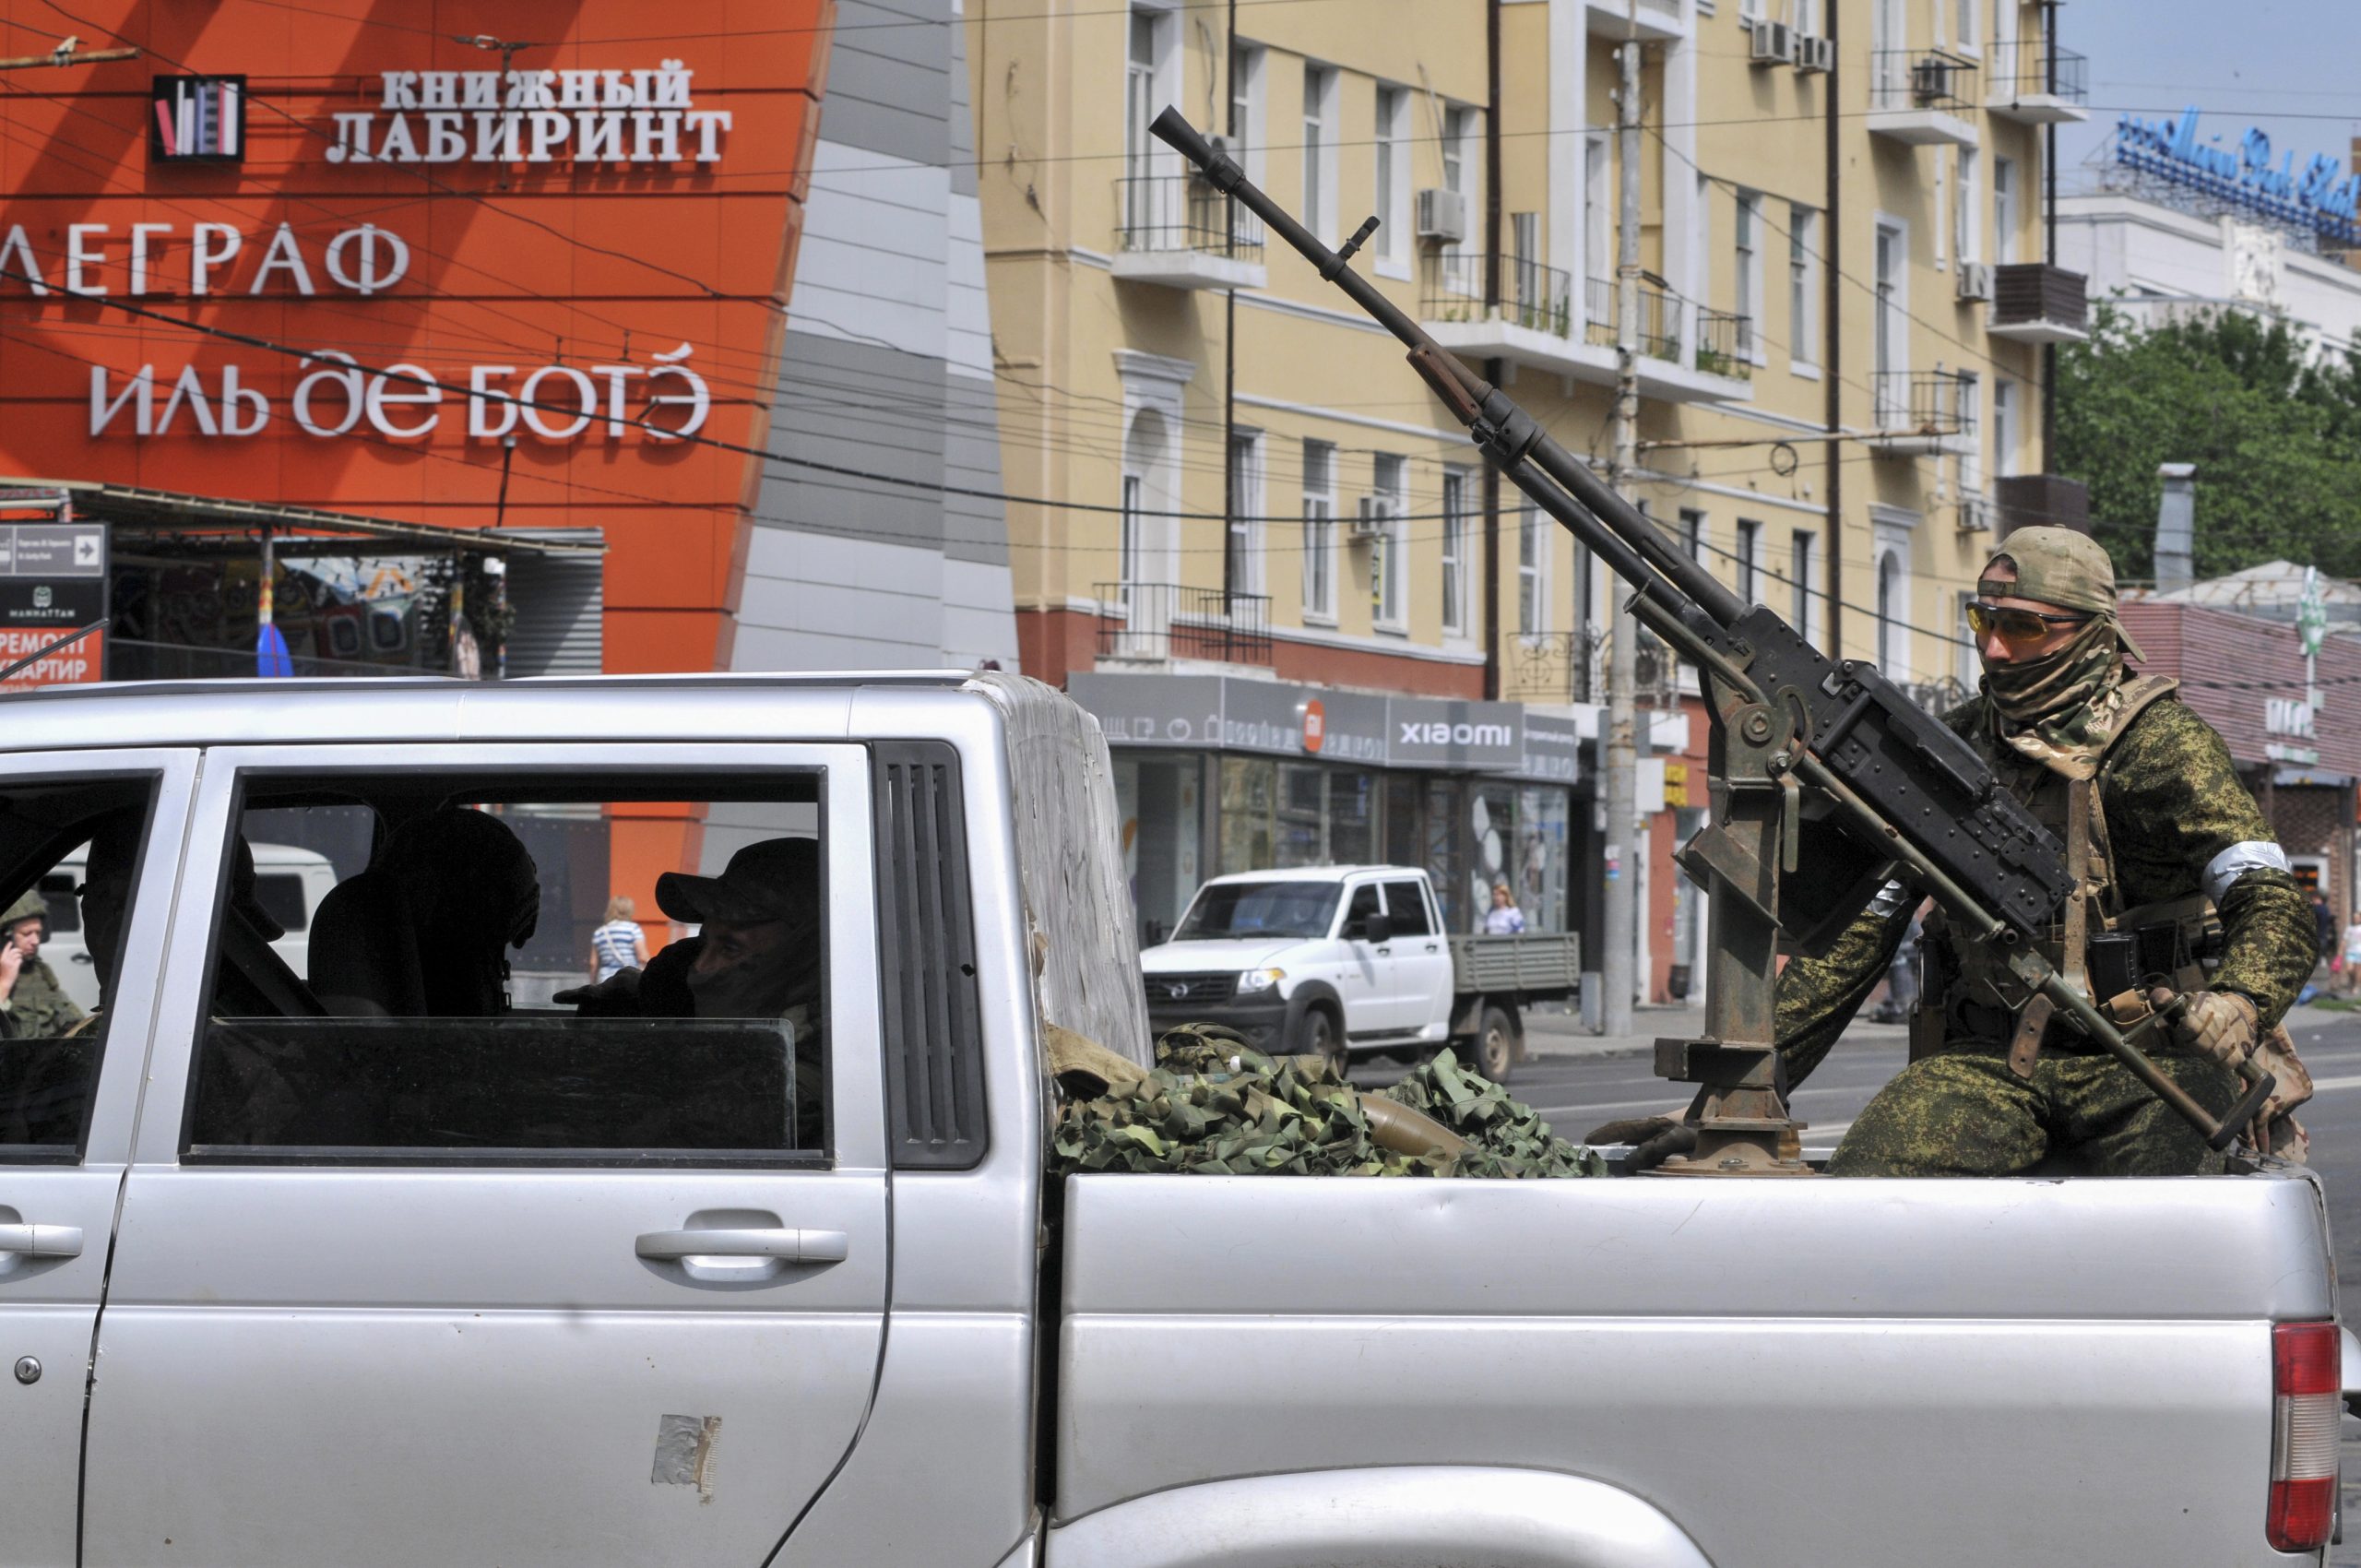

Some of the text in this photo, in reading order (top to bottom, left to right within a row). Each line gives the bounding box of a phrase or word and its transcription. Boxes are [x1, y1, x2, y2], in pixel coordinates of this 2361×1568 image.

[381, 59, 694, 110] КНИЖНЫЙ
[326, 111, 732, 163] ЛАБИРИНТ
[8, 609, 76, 619] MANHATTAN
